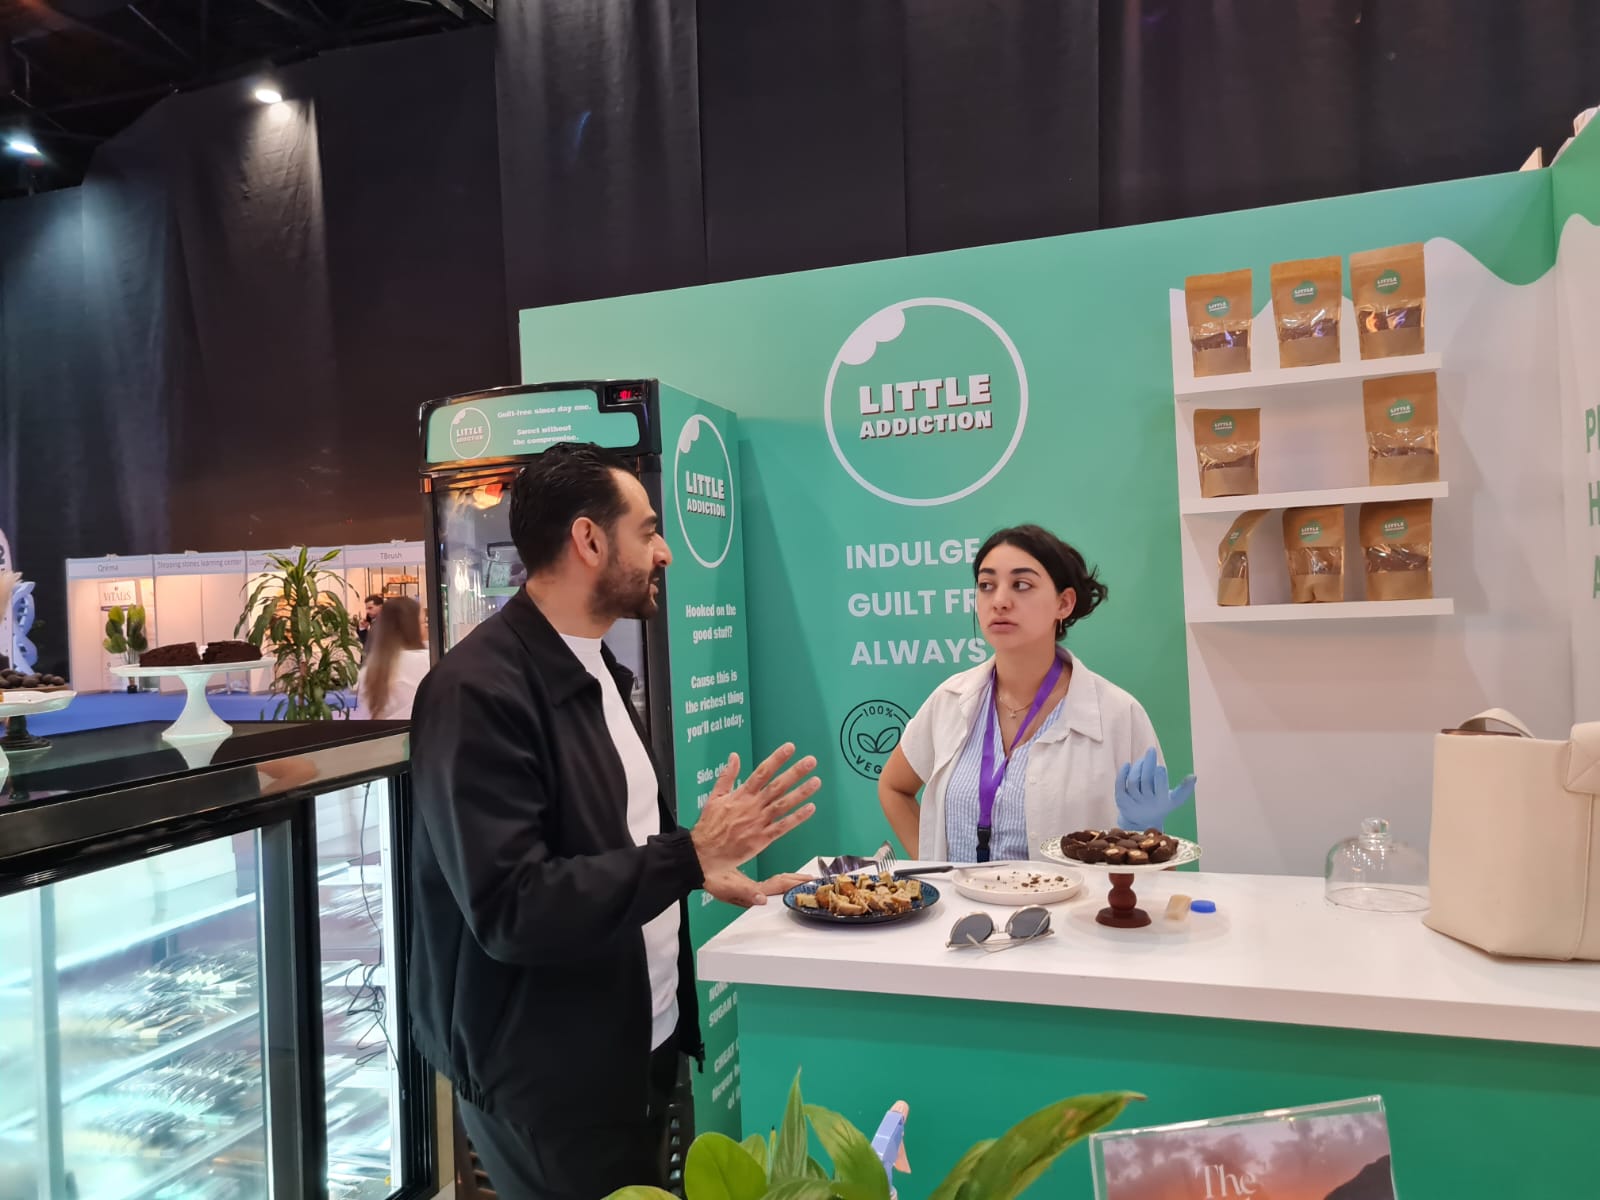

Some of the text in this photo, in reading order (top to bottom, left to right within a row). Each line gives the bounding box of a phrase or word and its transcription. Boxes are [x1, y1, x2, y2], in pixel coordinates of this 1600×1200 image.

[859, 374, 992, 415] LITTLE
[557, 405, 572, 415] day
[456, 426, 483, 437] LITTLE
[541, 425, 572, 434] without
[859, 410, 992, 439] ADDICTION
[686, 470, 725, 500] LITTLE
[687, 498, 726, 518] ADDICTION
[846, 538, 981, 569] INDULGE
[685, 603, 736, 618] Hooked on the
[848, 589, 978, 617] GUILT FR
[692, 625, 733, 644] good stuff?
[850, 638, 986, 666] ALWAYS
[691, 669, 738, 689] Cause this is
[685, 690, 744, 715] the richest thing
[863, 705, 894, 718] 100%
[687, 712, 745, 743] you'll eat today.
[856, 755, 882, 774] VEG
[696, 767, 714, 785] Side
[1195, 1163, 1258, 1198] The
